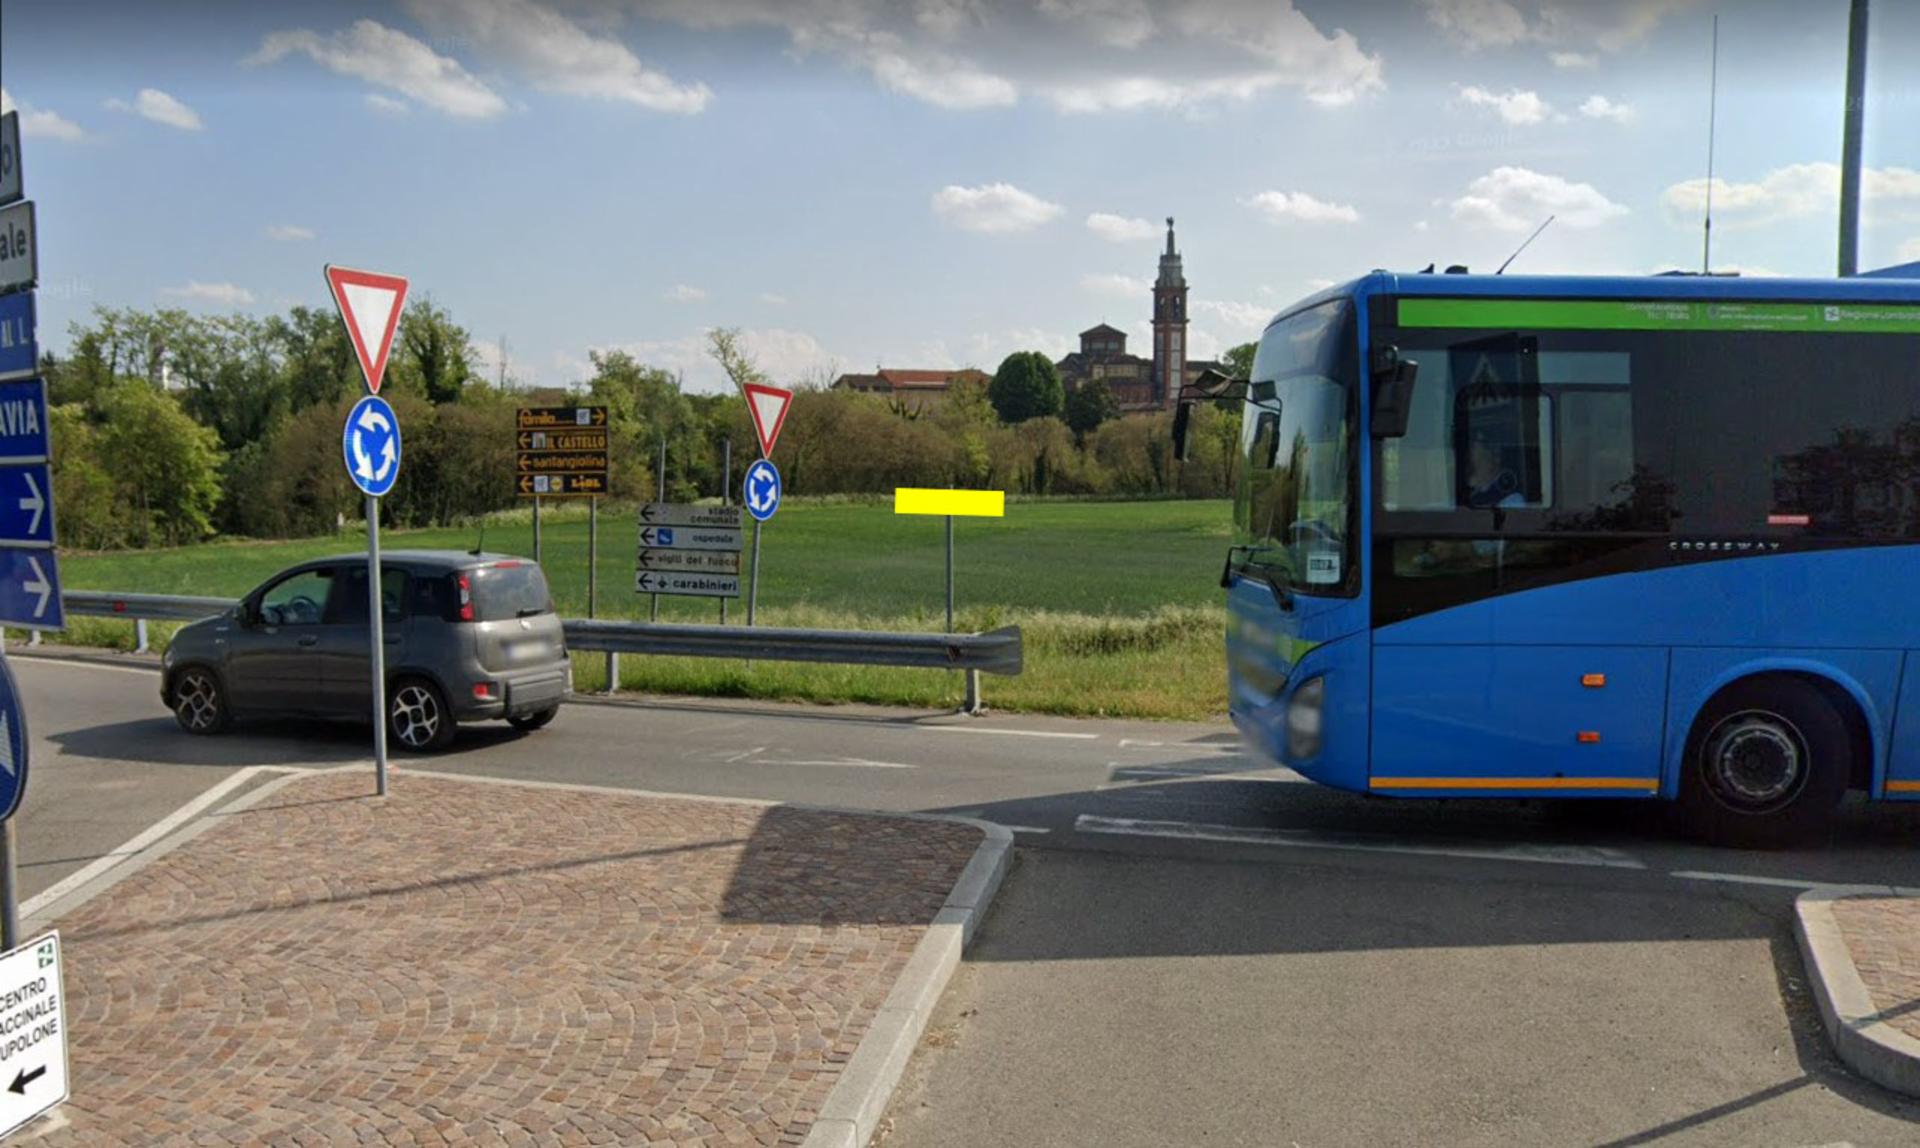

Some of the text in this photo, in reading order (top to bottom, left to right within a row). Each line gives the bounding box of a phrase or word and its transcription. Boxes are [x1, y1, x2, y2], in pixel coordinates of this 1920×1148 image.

[557, 435, 606, 449] CASTELLO
[690, 515, 740, 525] comunale
[692, 533, 734, 544] ospedale
[1669, 542, 1780, 550] CROSSWAY
[658, 554, 739, 567] vigili del fuoco
[672, 578, 738, 591] carabinieri
[0, 976, 47, 1014] CENTRO
[0, 1017, 58, 1062] UPOLONE
